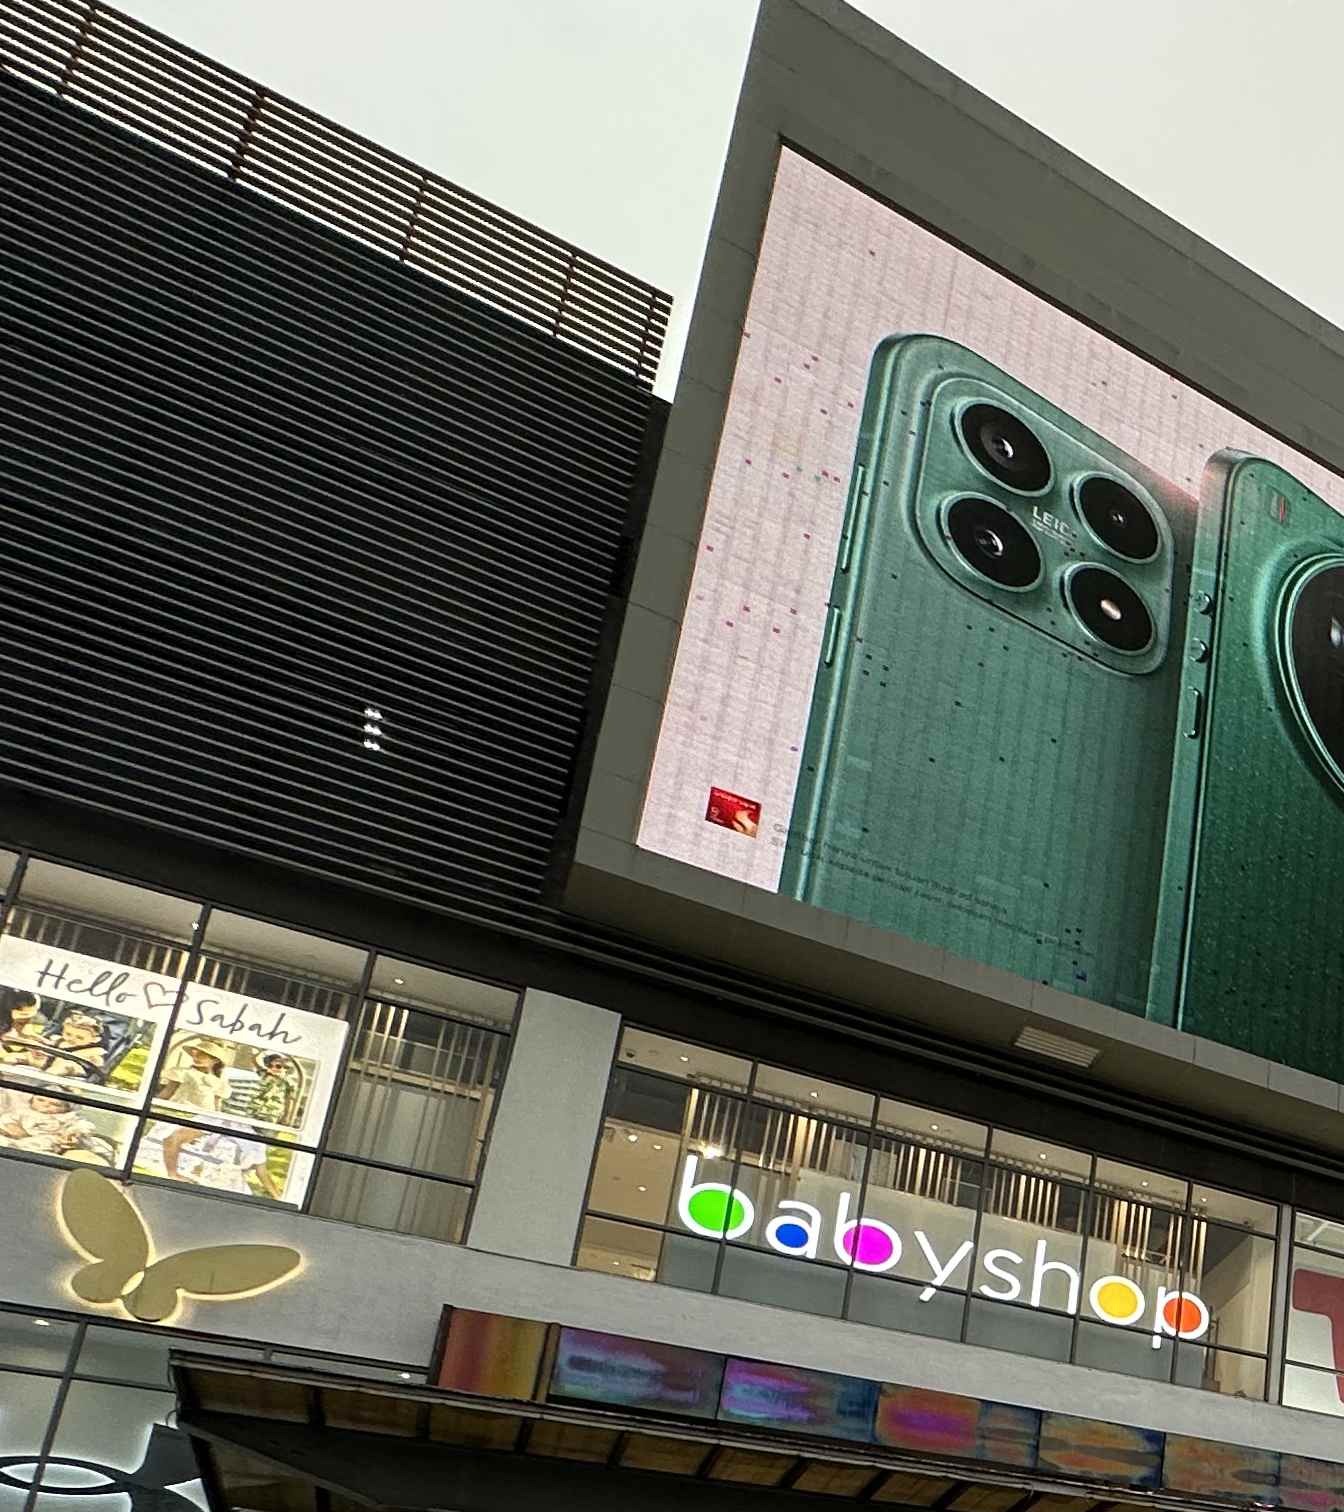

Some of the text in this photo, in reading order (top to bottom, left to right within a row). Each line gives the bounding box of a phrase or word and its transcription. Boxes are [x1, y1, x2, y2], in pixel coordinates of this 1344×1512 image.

[36, 957, 303, 1047] Hello Sabah
[678, 1155, 1211, 1349] babyshop
